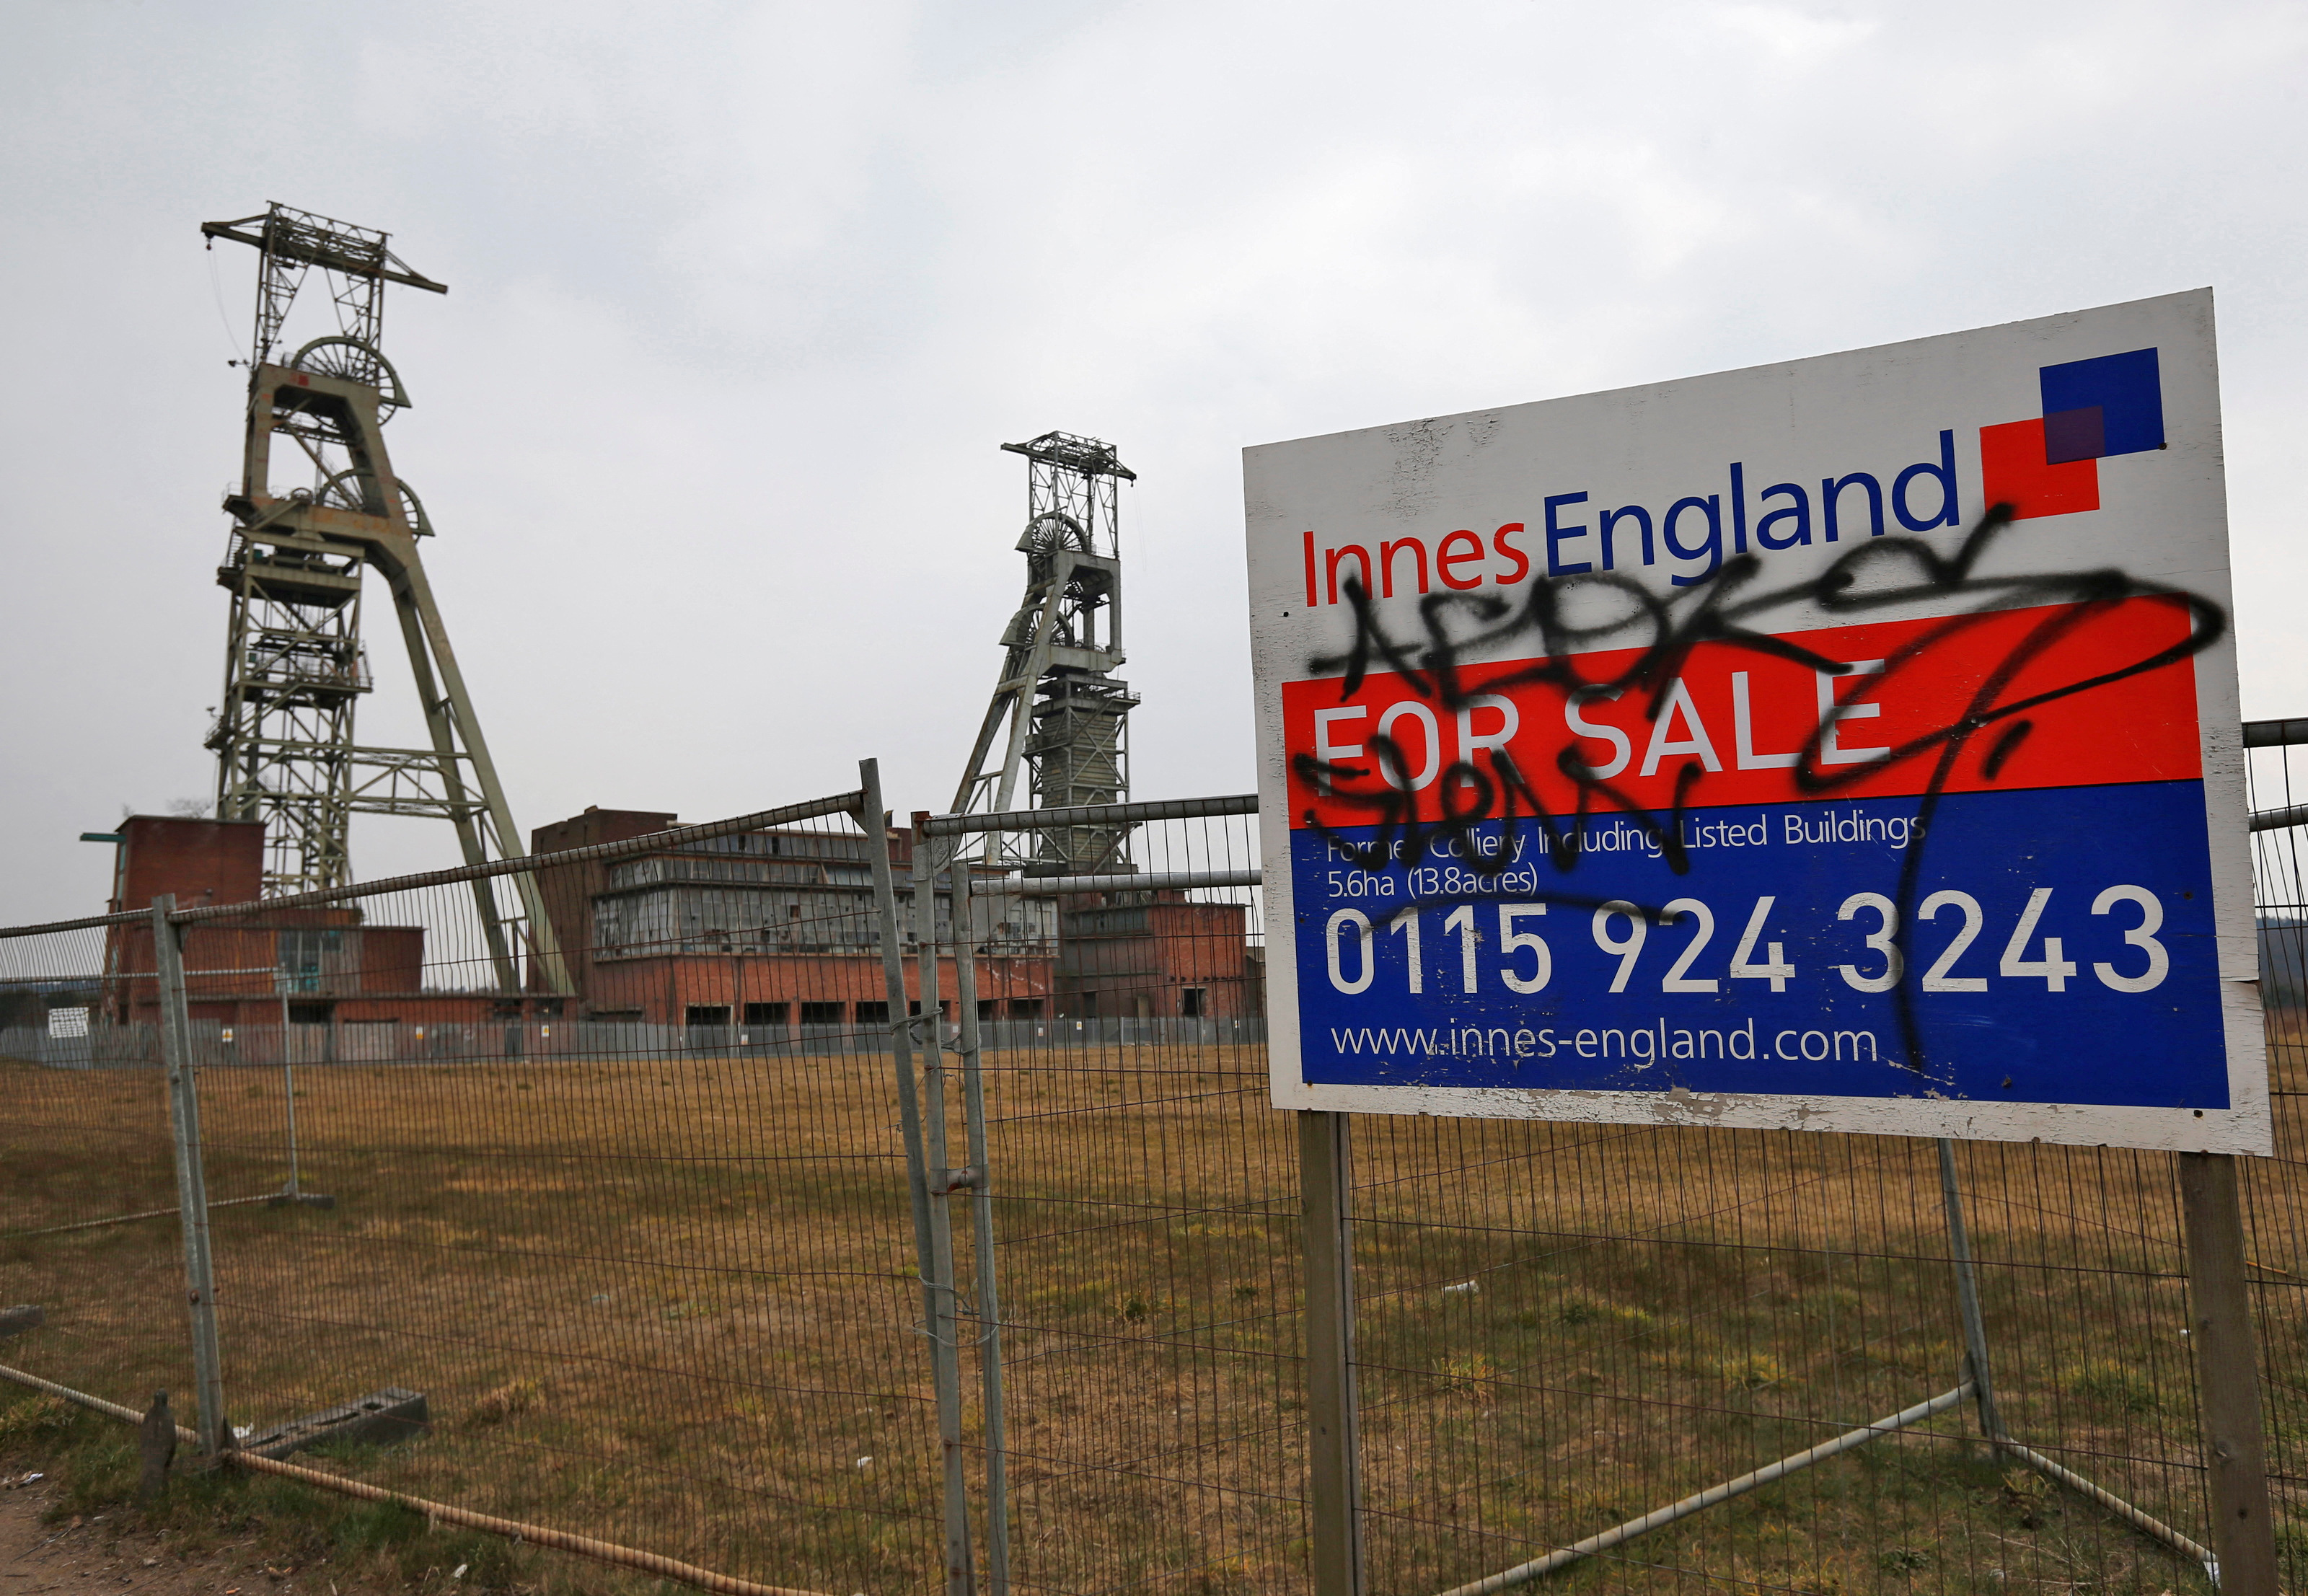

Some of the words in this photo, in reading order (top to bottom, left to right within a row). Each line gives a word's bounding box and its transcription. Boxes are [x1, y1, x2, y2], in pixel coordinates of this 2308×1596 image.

[1314, 694, 1525, 797] FOR
[1564, 658, 1890, 780] SALE
[1680, 814, 1767, 849] Listed
[1784, 808, 1926, 850] Buildings
[1328, 868, 1396, 898] 5.6ha
[1407, 863, 1538, 900] (13.8acres)
[1325, 902, 1552, 995] 0115
[1591, 896, 1796, 993] 924
[1836, 884, 2170, 994] 3243
[1330, 1016, 1878, 1071] www.innes-england.com
